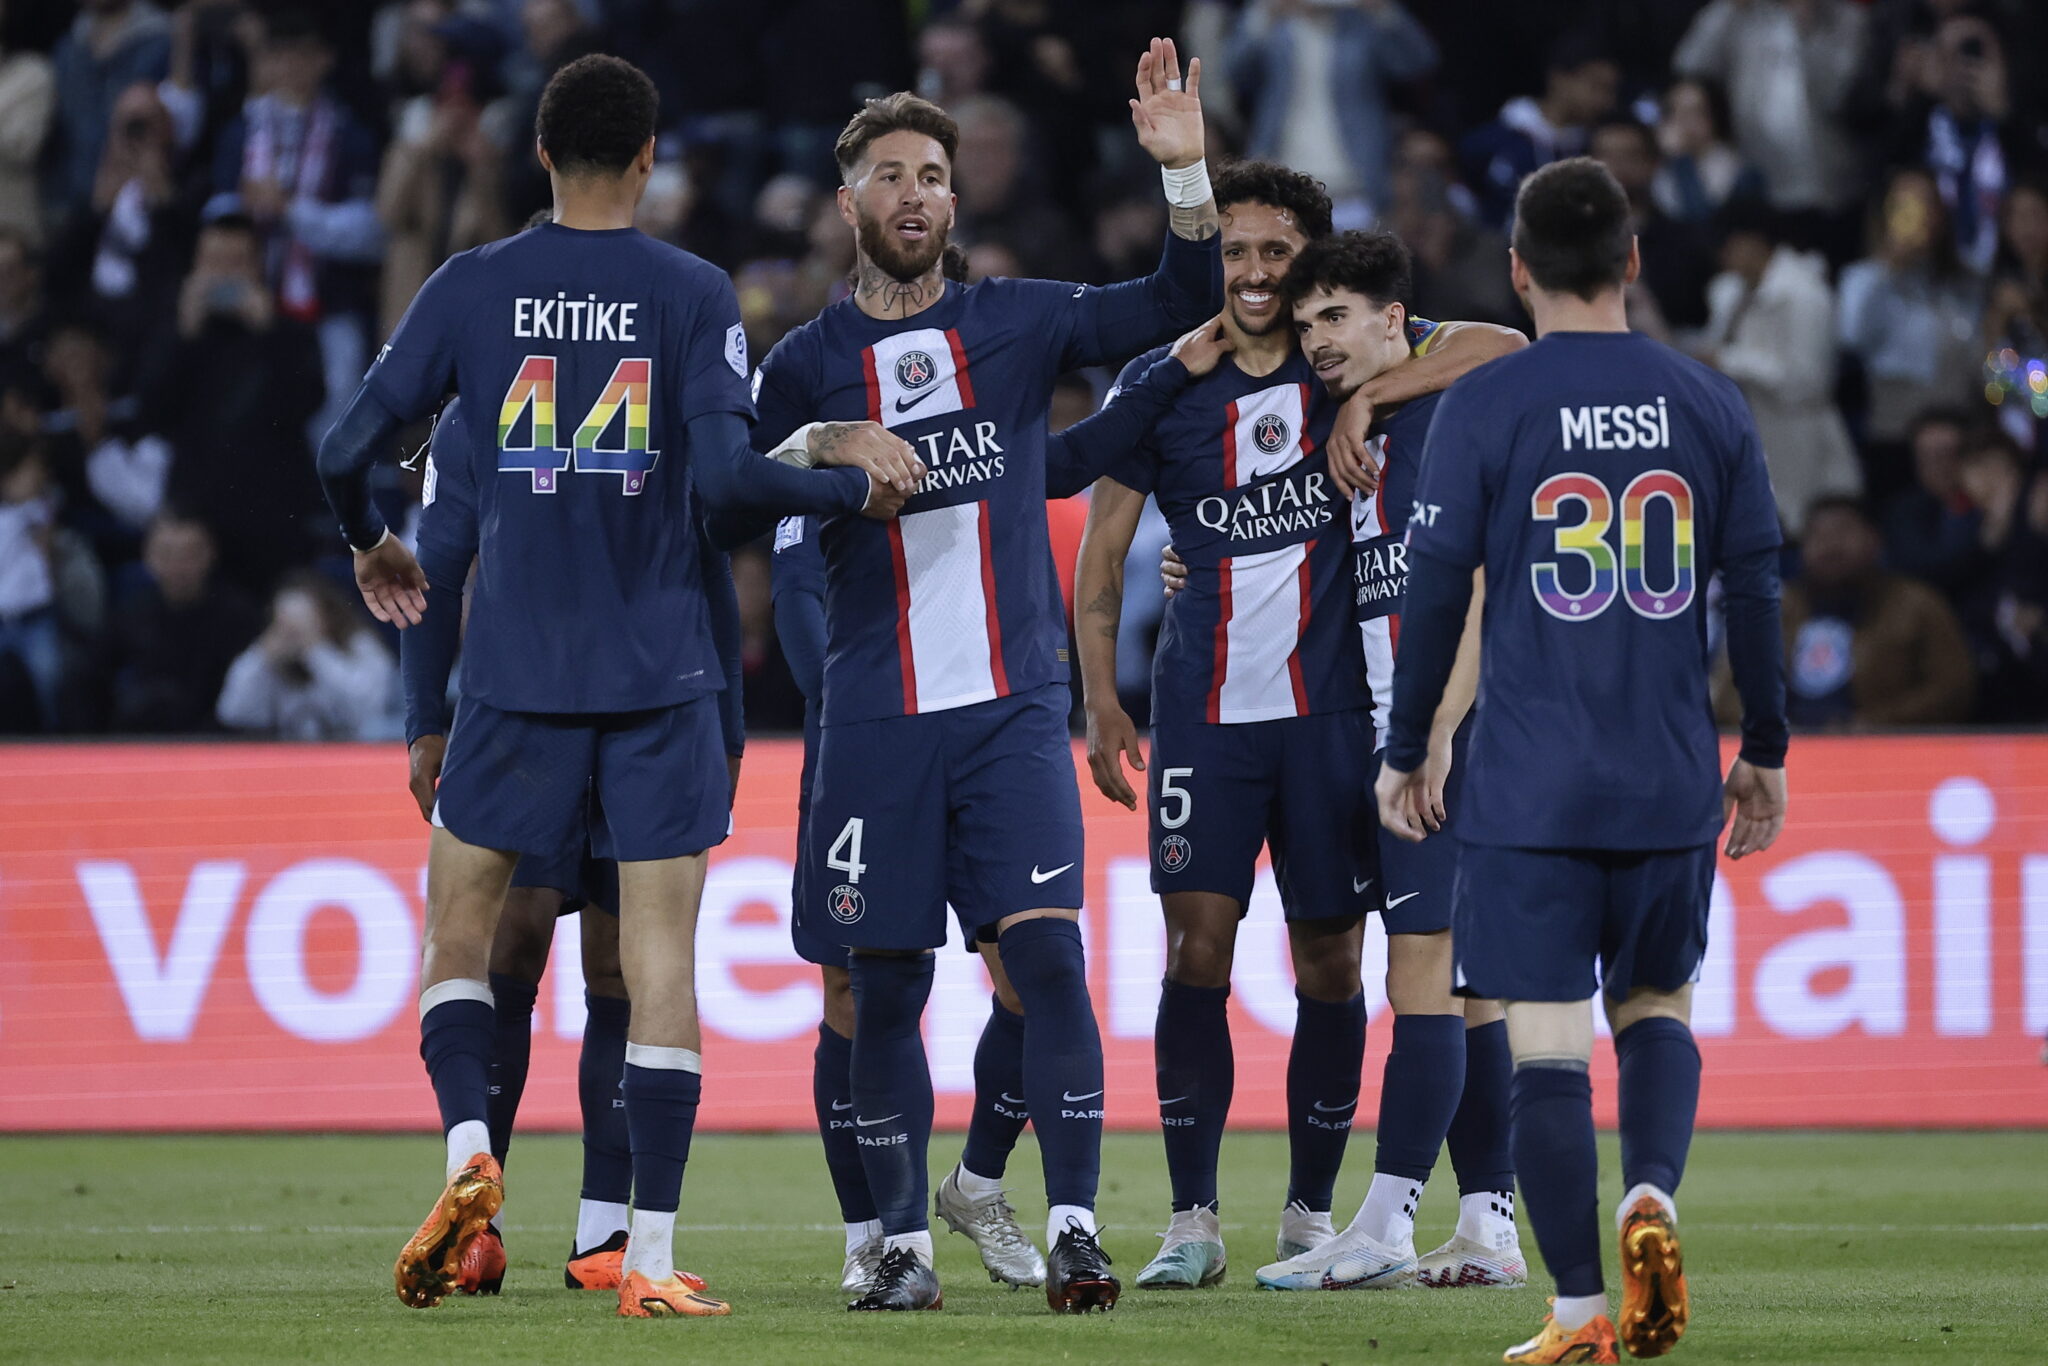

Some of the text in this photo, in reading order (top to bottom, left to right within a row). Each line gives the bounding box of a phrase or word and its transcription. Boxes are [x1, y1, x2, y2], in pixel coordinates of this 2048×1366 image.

[900, 354, 926, 367] PARIS
[497, 355, 661, 495] 44
[1258, 417, 1281, 428] PARIS
[912, 456, 1005, 495] IRWAYS
[1196, 472, 1330, 533] QATAR
[1230, 505, 1333, 541] AIRWAYS
[1531, 469, 1696, 621] 30
[1160, 768, 1194, 829] 5
[827, 817, 867, 884] 4
[1163, 836, 1185, 846] PARIS
[835, 887, 859, 899] PARIS
[857, 1133, 908, 1146] PARIS
